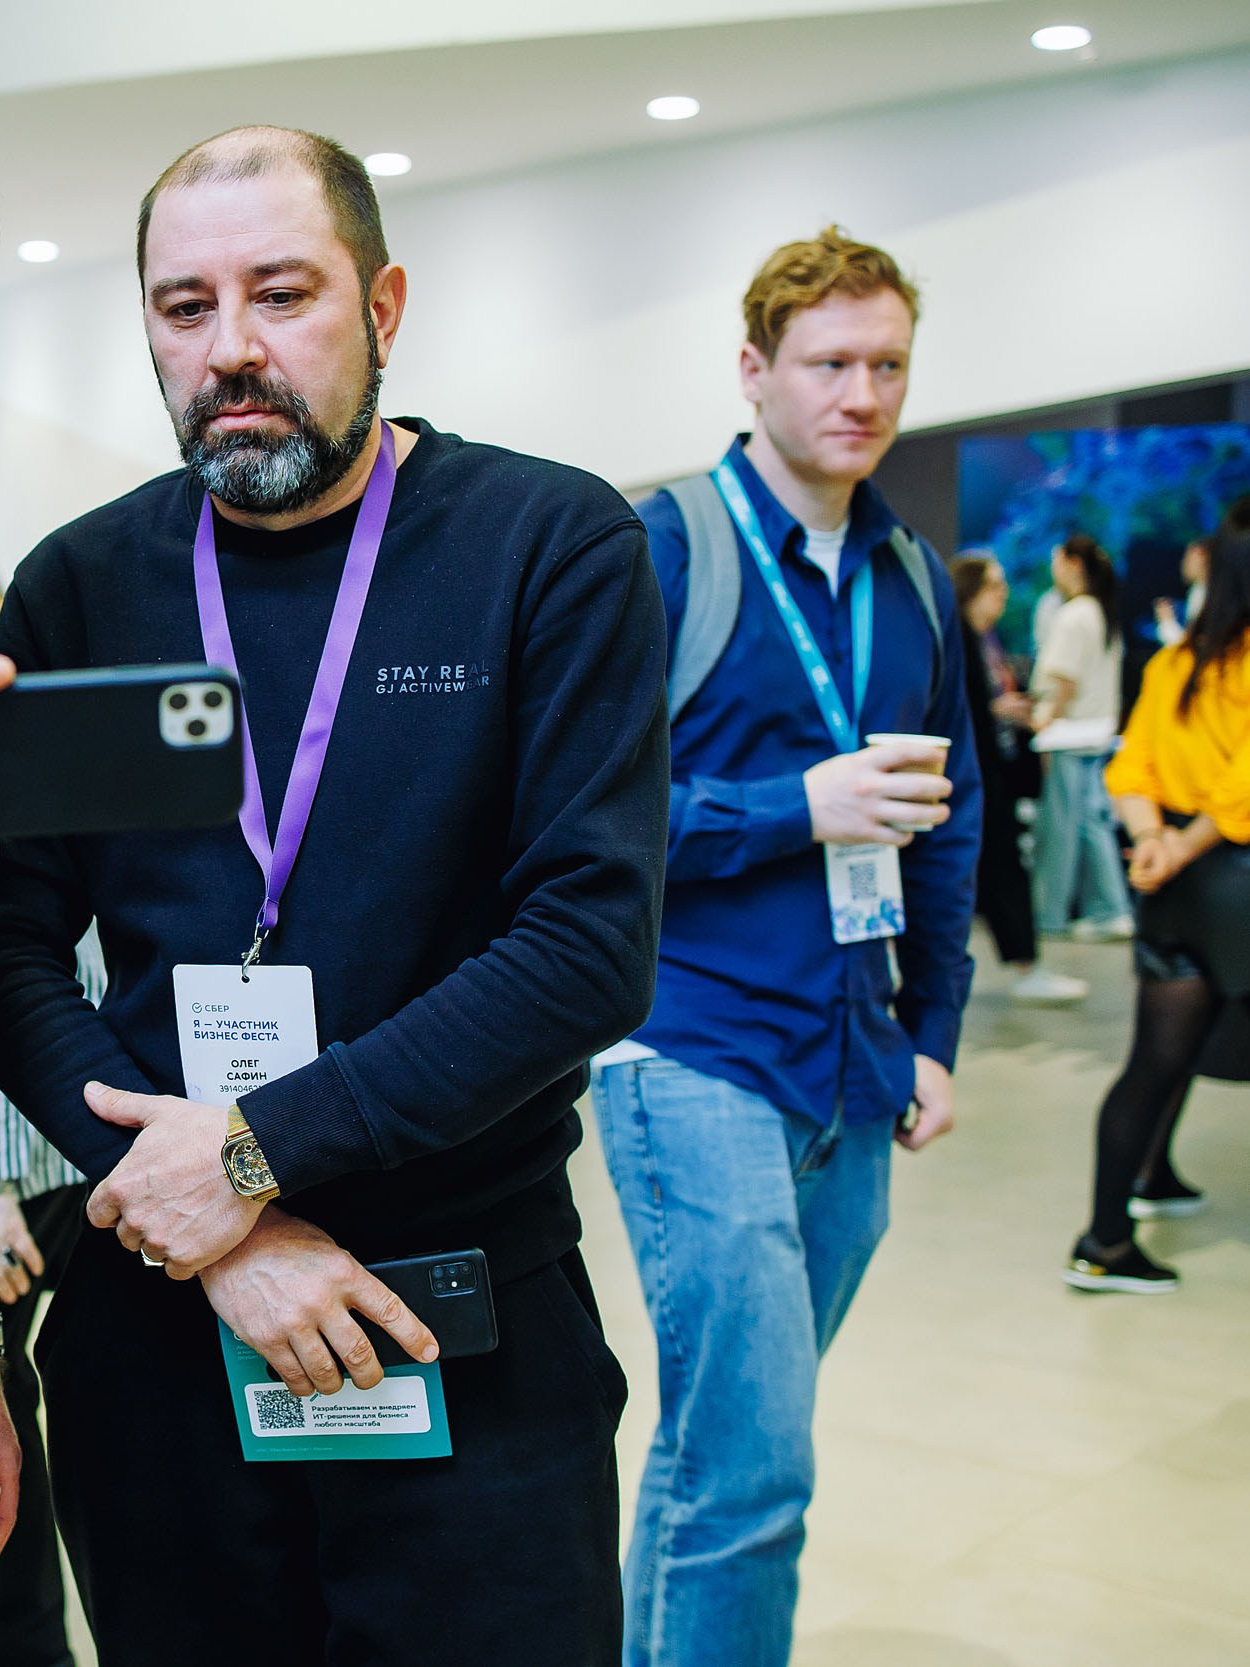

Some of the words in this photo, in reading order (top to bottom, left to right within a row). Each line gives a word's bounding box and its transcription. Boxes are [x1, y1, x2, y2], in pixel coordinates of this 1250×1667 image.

[377, 665, 429, 681] STAY
[376, 684, 394, 694] GJ
[204, 1004, 230, 1013] СБЕР
[193, 1019, 200, 1028] Я
[216, 1020, 279, 1030] УЧАСТНИК
[194, 1030, 238, 1041] БИЗНЕС
[241, 1031, 280, 1041] ФЕСТА
[231, 1059, 259, 1068] ОЛЕГ
[226, 1071, 267, 1081] САФИН
[311, 1404, 371, 1412] Разрабатываем
[378, 1403, 417, 1412] внедряем
